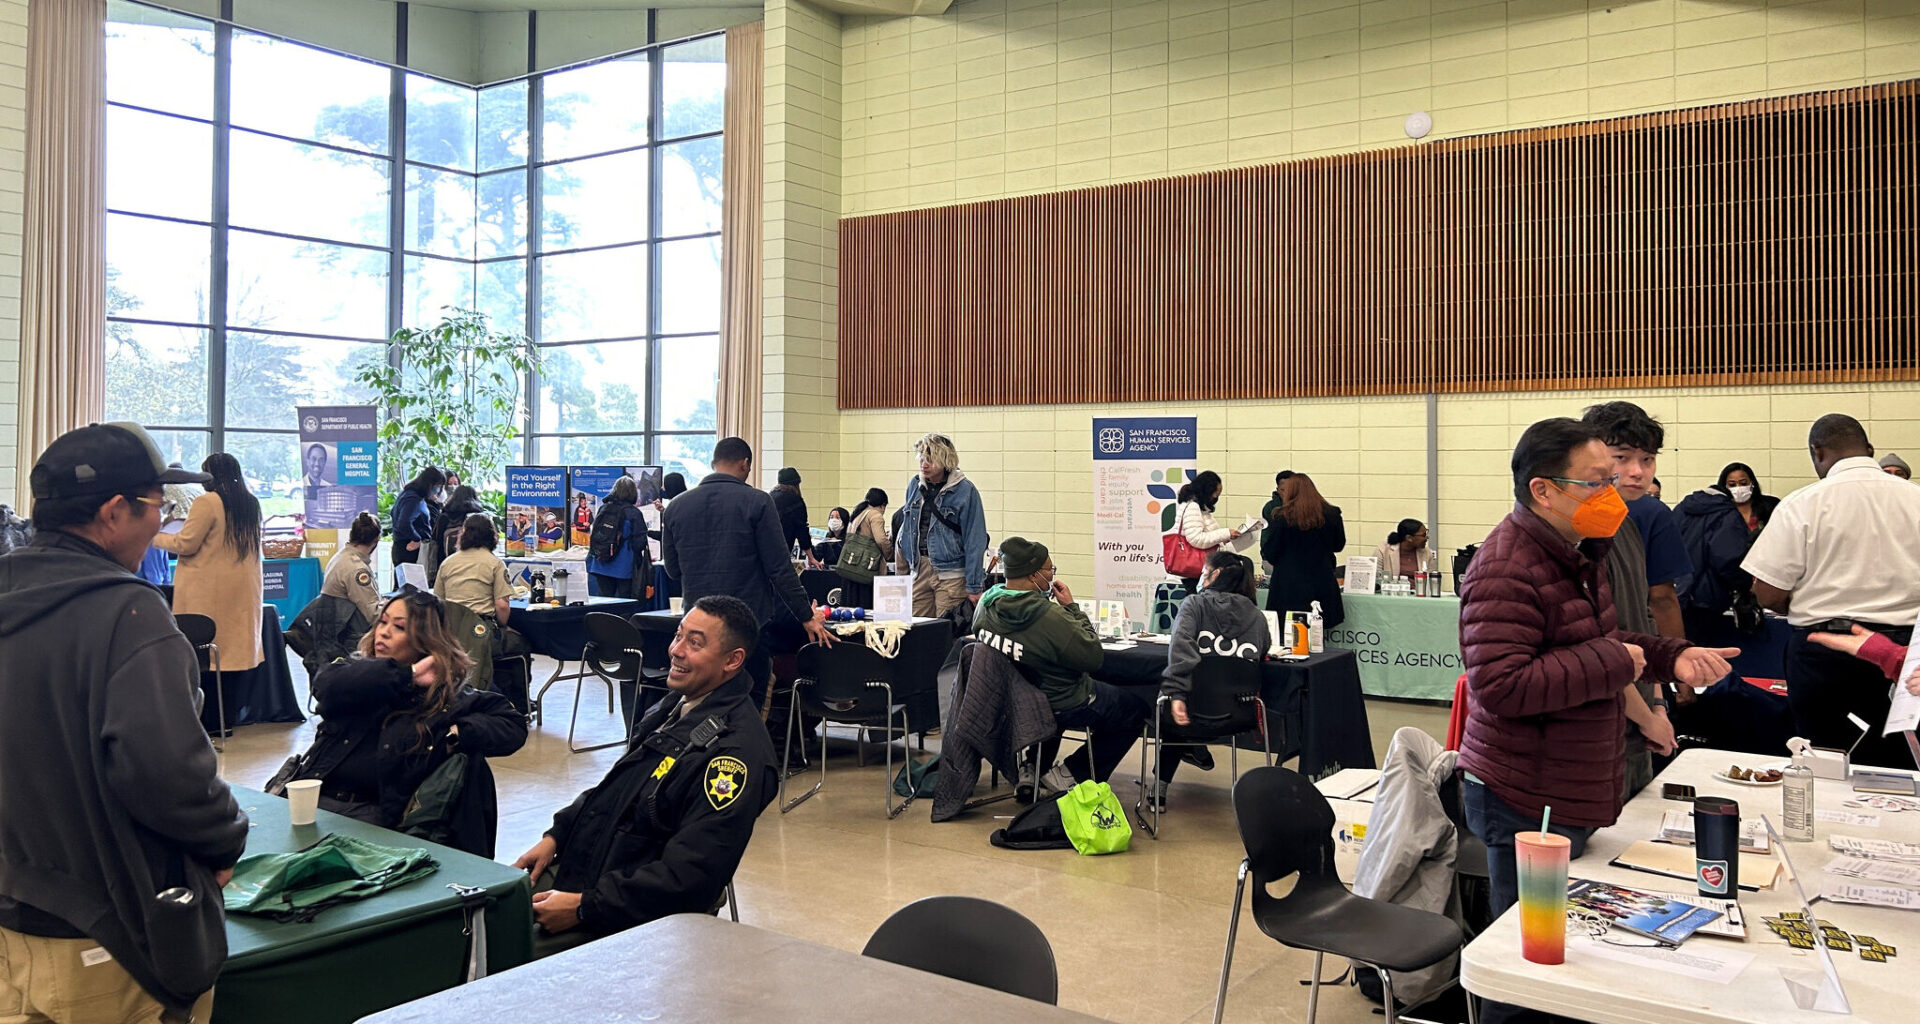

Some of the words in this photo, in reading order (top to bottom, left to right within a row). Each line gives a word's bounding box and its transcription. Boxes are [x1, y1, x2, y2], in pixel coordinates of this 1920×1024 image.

[1098, 542, 1122, 551] With
[1124, 544, 1144, 552] you
[1130, 554, 1154, 562] life's
[979, 628, 1024, 661] STAFF
[1394, 652, 1464, 668] AGENCY
